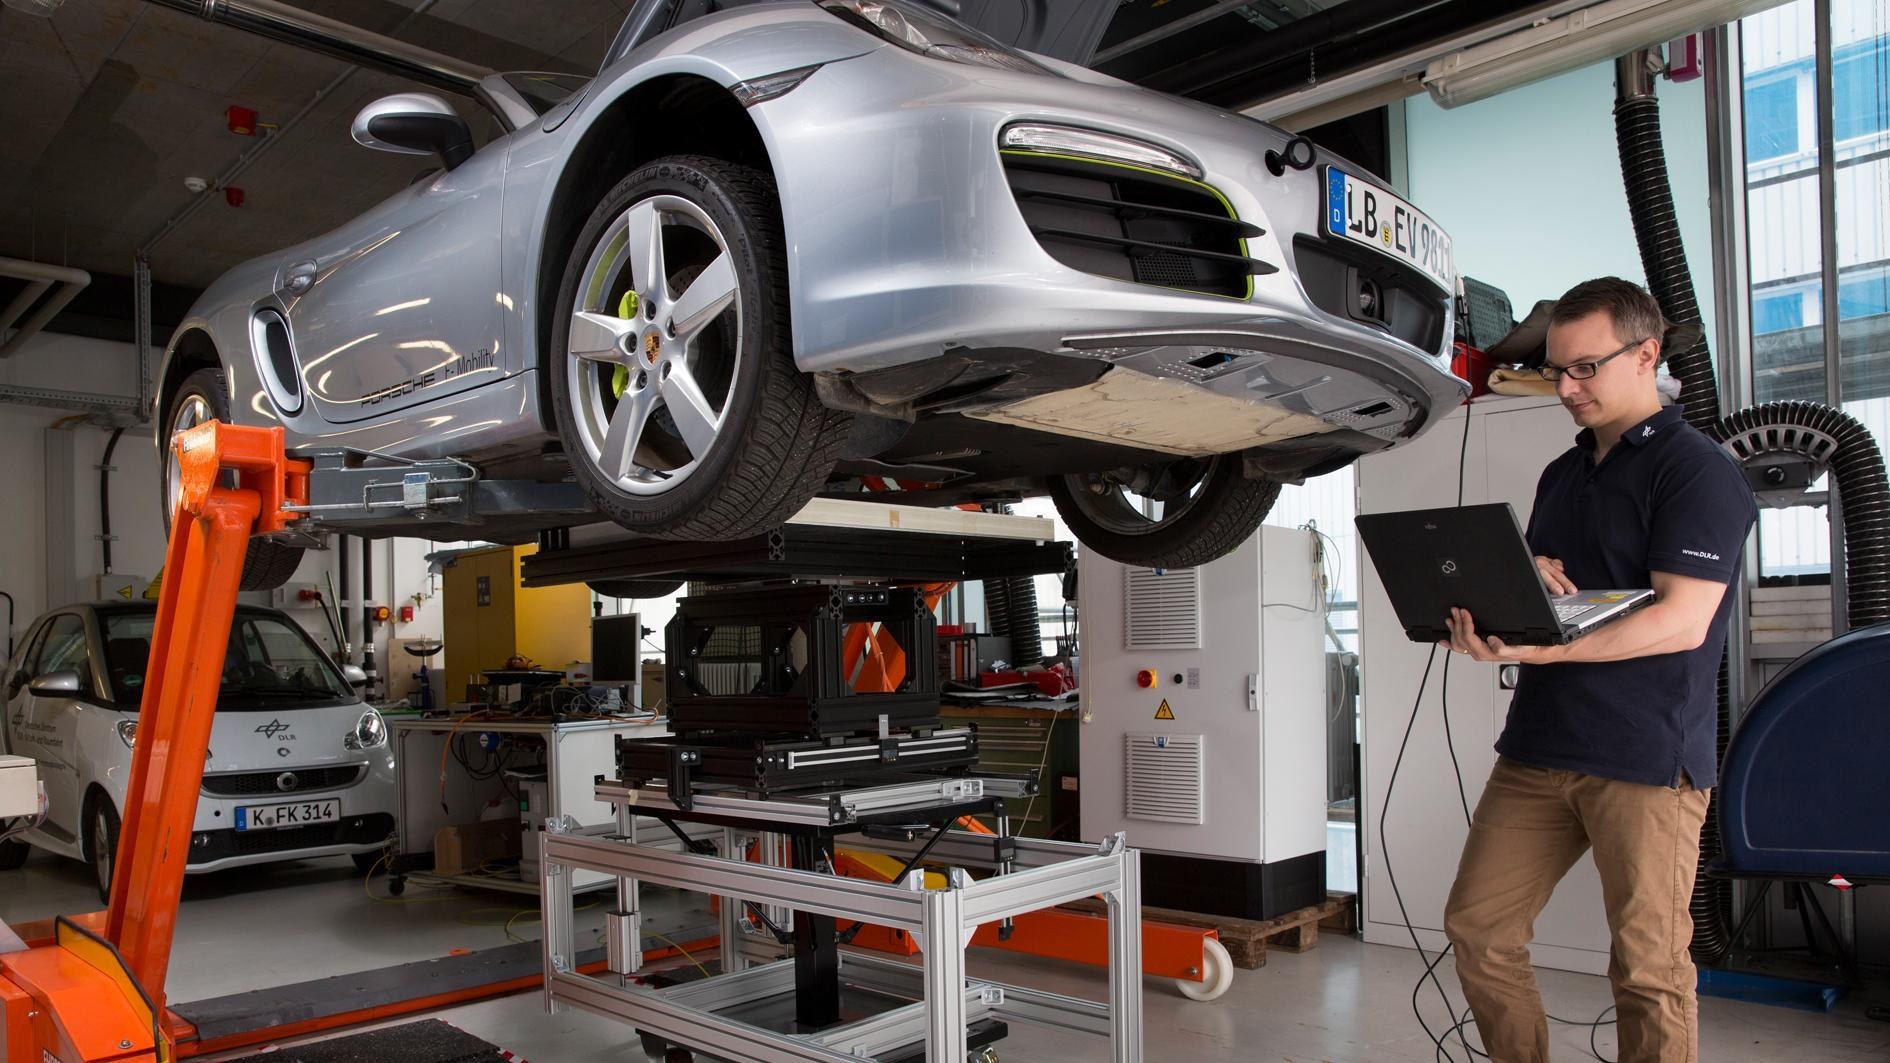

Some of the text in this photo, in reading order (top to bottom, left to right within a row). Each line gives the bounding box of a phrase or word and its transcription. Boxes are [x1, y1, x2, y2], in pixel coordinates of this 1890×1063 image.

[1333, 208, 1341, 223] D
[1347, 183, 1378, 238] LB
[1394, 205, 1417, 259] EV
[738, 239, 753, 275] Pilot
[1682, 549, 1720, 561] www.DLR.de
[253, 803, 332, 826] K FK 314
